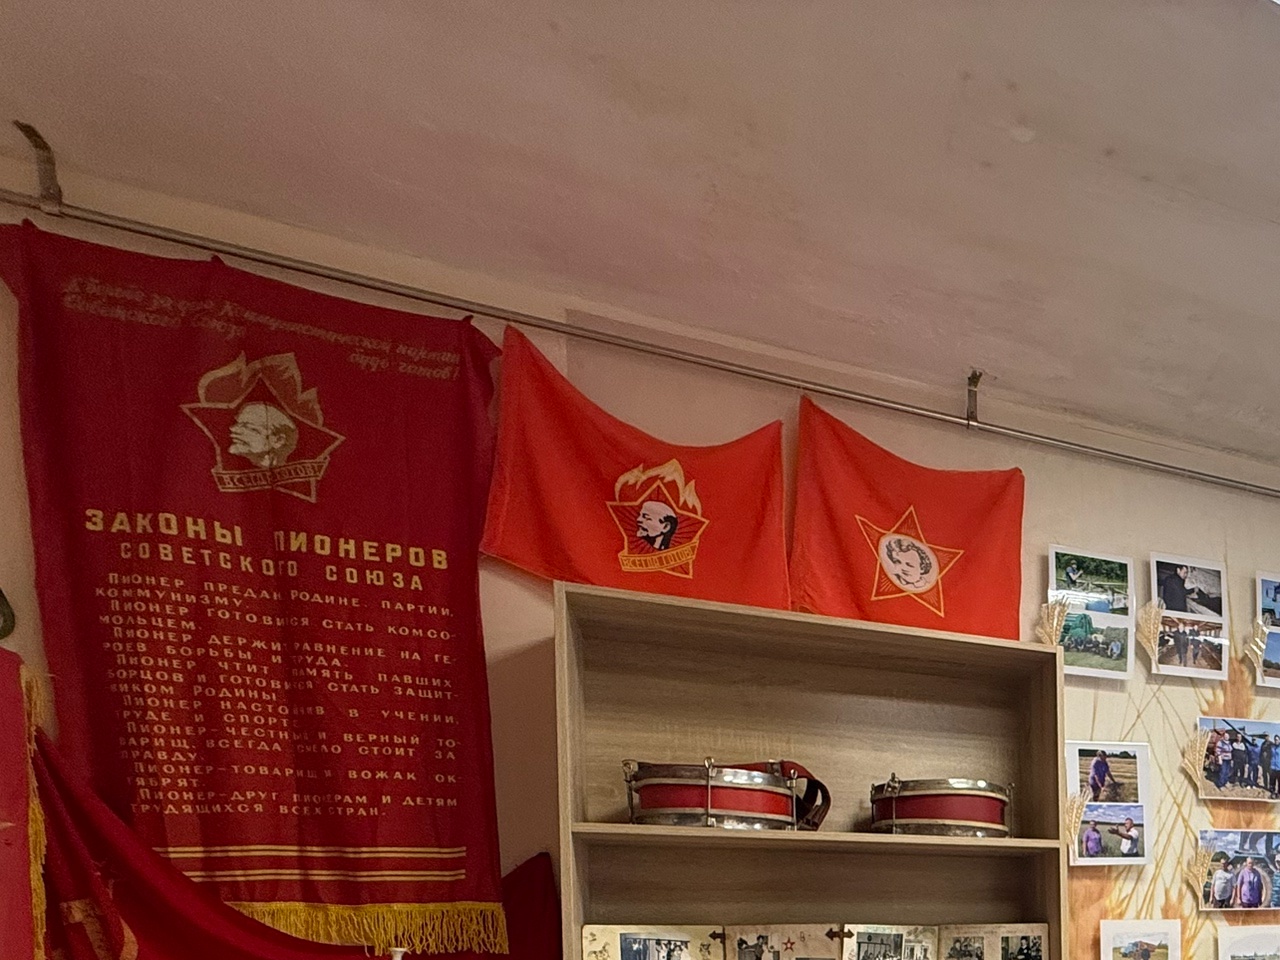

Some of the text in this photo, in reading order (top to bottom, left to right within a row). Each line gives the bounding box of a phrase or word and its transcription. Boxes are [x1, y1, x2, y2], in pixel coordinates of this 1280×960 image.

[85, 508, 449, 571] ЗАКОНЫ ПИОНЕРОВ
[119, 542, 424, 592] СОВЕТСКОГО СОЮЗА
[108, 573, 185, 589] ПИОНЕР
[203, 581, 281, 601] ПРЕДАН
[110, 600, 190, 617] ПИОНЕР
[321, 618, 375, 633] СТАТЬ
[387, 625, 456, 641] КОМСО-
[113, 627, 193, 644] ПИОНЕР
[401, 650, 422, 662] НА
[165, 644, 253, 662] БОРЬБЫ
[271, 654, 283, 665] И
[116, 653, 453, 689] ПИОНЕР ЧТИТ ПАМЯТЬ ПАВШИХ
[197, 673, 208, 684] И
[326, 681, 380, 695] СТАТЬ
[393, 685, 459, 701] ЗАЩИТ-
[122, 694, 202, 711] ПИОНЕР
[348, 708, 360, 719] В
[194, 713, 205, 723] И
[205, 739, 282, 753] ВСЕГДА
[357, 746, 416, 758] СТОИТ
[434, 750, 457, 761] ЗА
[317, 731, 327, 741] И
[343, 732, 420, 746] ВЕРНЫЙ
[324, 769, 333, 779] И
[347, 769, 417, 782] ВОЖАК
[131, 803, 264, 815] ТРУДЯЩИХСЯ
[279, 804, 322, 816] ВСЕХ
[381, 795, 392, 805] И
[402, 796, 458, 808] ДЕТЯМ
